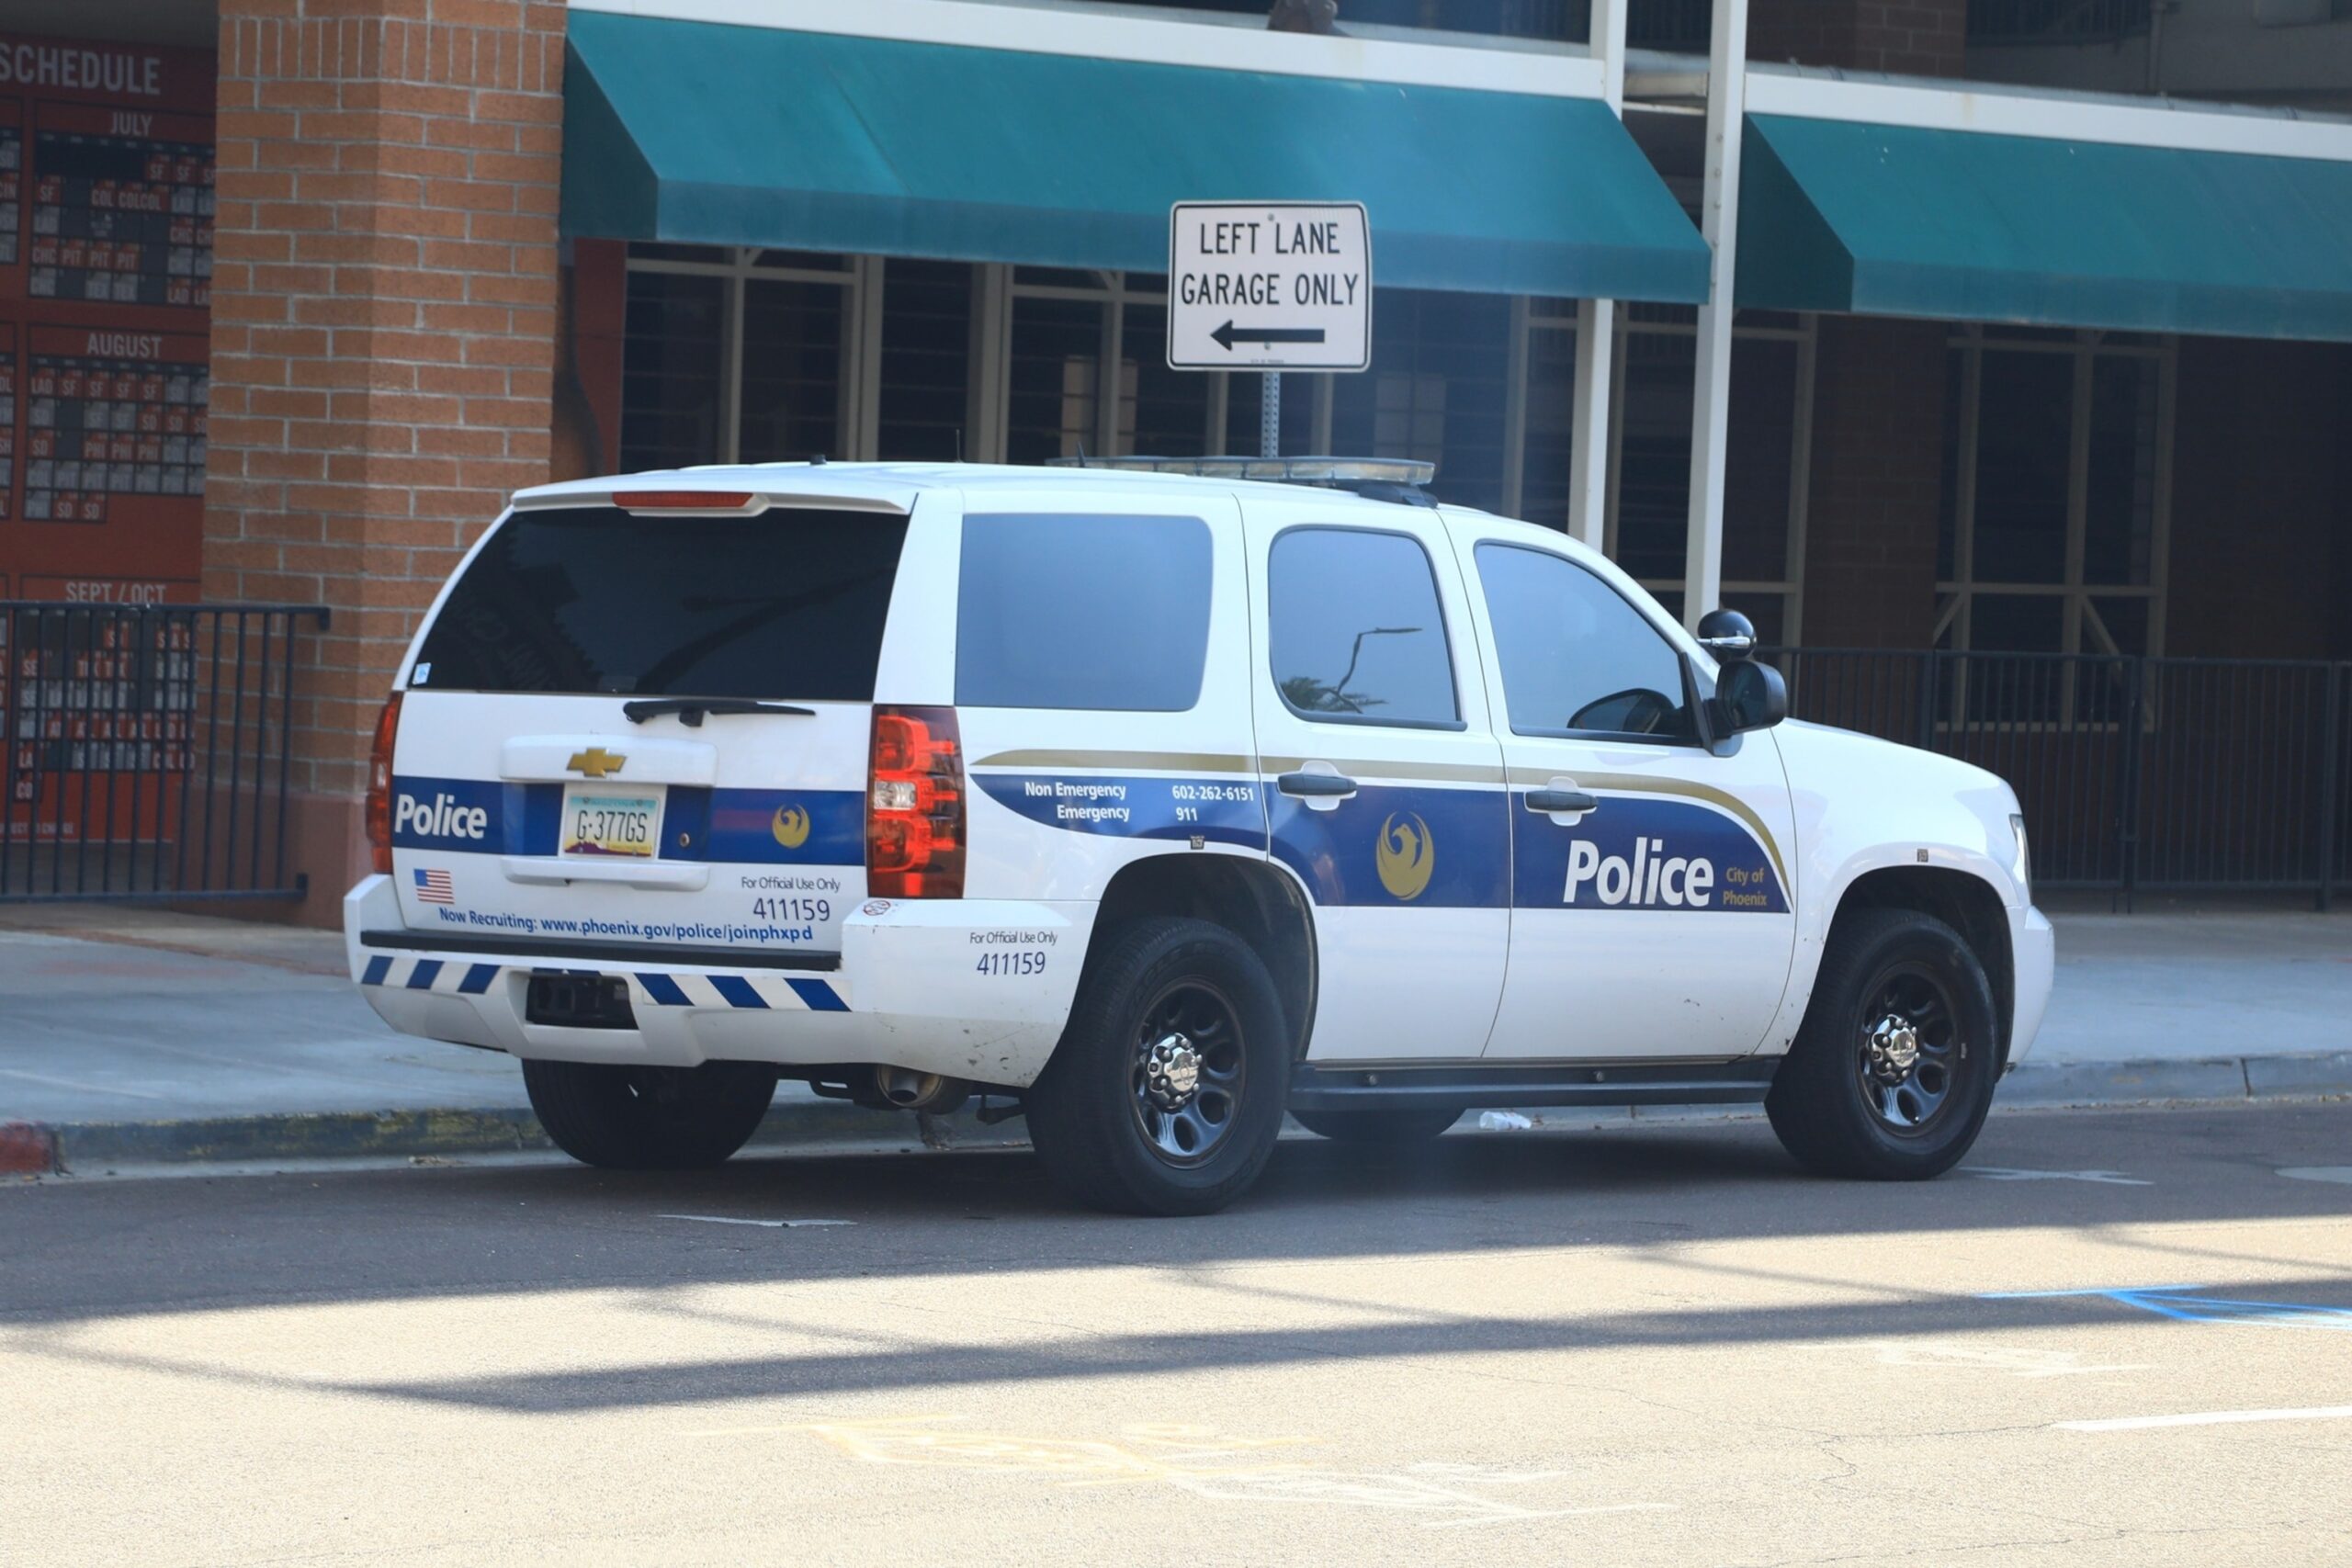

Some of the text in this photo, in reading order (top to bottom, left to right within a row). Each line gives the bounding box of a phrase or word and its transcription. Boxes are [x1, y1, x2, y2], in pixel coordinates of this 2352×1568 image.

[0, 42, 161, 96] SCHEDULE
[110, 111, 153, 137] JULY
[40, 186, 54, 201] SF
[1201, 223, 1340, 254] LEFT LANE
[1182, 274, 1358, 305] GARAGE ONLY
[87, 333, 162, 358] AUGUST
[90, 381, 104, 397] SF
[117, 383, 130, 398] SF
[143, 384, 157, 399] SF
[65, 581, 112, 603] SEPT
[131, 584, 166, 604] OCT
[1025, 782, 1254, 801] Non Emergency 602-262-6151
[395, 794, 487, 839] Police
[1057, 805, 1198, 822] Emergency 911
[1563, 837, 1714, 907] Police
[1726, 867, 1764, 886] City of
[741, 877, 840, 893] For Official Use Only
[753, 897, 831, 921] 411159
[1723, 890, 1767, 906] Phoenix
[439, 908, 466, 922] Now
[469, 910, 537, 932] Recruiting:
[970, 931, 1057, 946] For Official Use Only
[977, 951, 1046, 976] 411159
